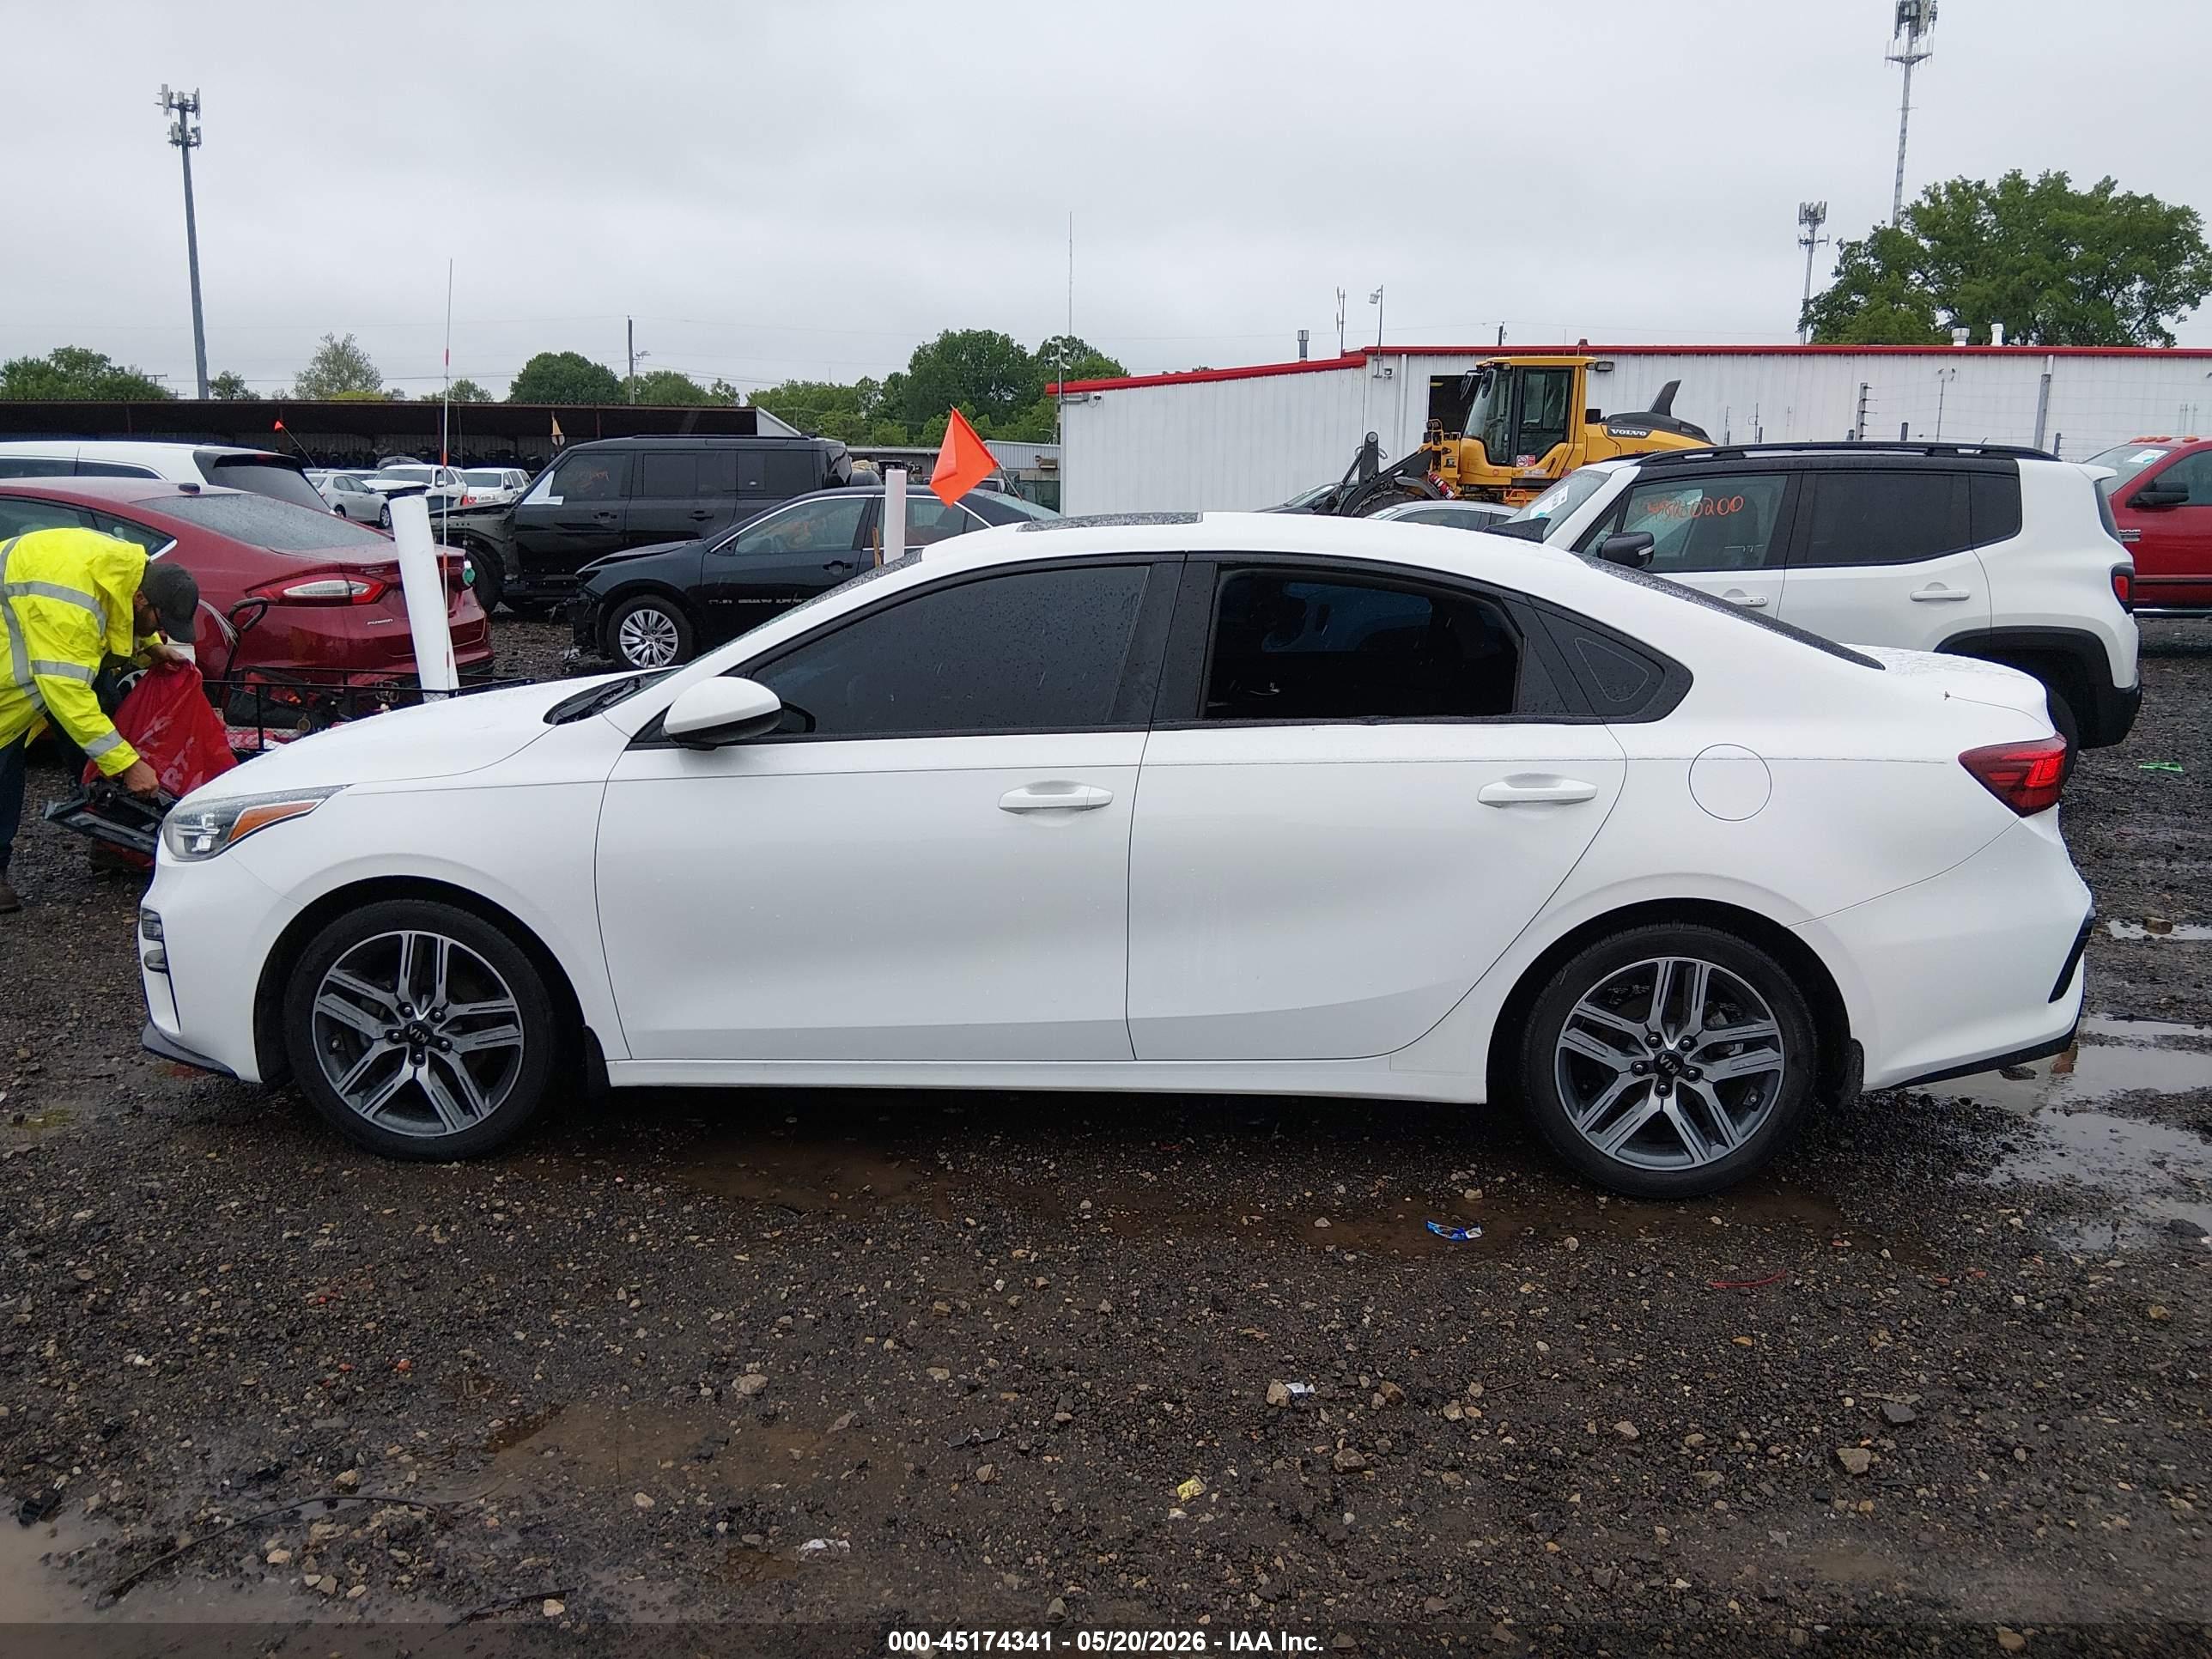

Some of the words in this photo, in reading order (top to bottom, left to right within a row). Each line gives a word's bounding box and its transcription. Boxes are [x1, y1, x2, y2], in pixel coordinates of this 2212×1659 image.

[1610, 428, 1648, 437] VOLVO
[407, 1024, 429, 1045] KIA
[1658, 1054, 1680, 1075] KIA
